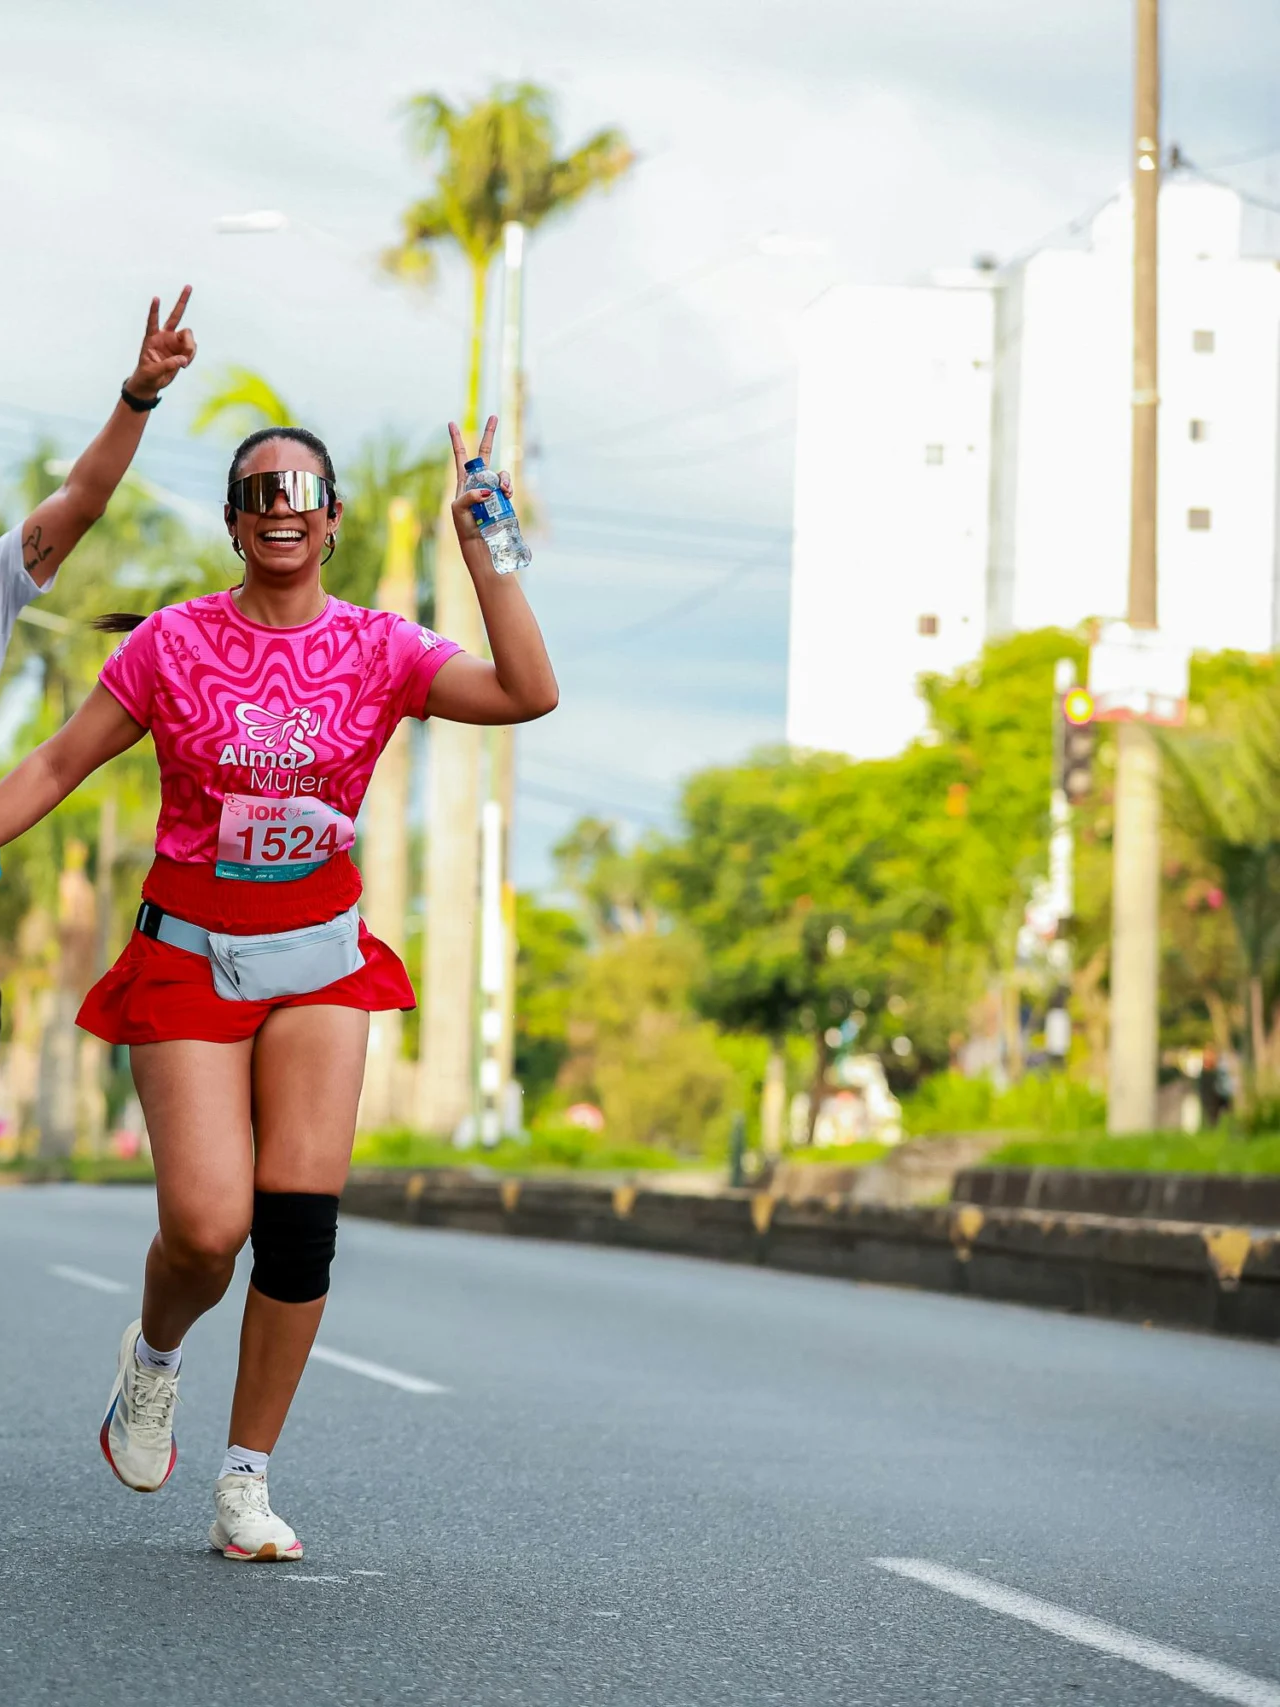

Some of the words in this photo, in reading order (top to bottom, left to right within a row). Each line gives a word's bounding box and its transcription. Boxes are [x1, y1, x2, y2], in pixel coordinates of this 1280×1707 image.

[250, 769, 328, 798] Mujer
[245, 804, 287, 821] 10K
[236, 823, 339, 861] 1524
